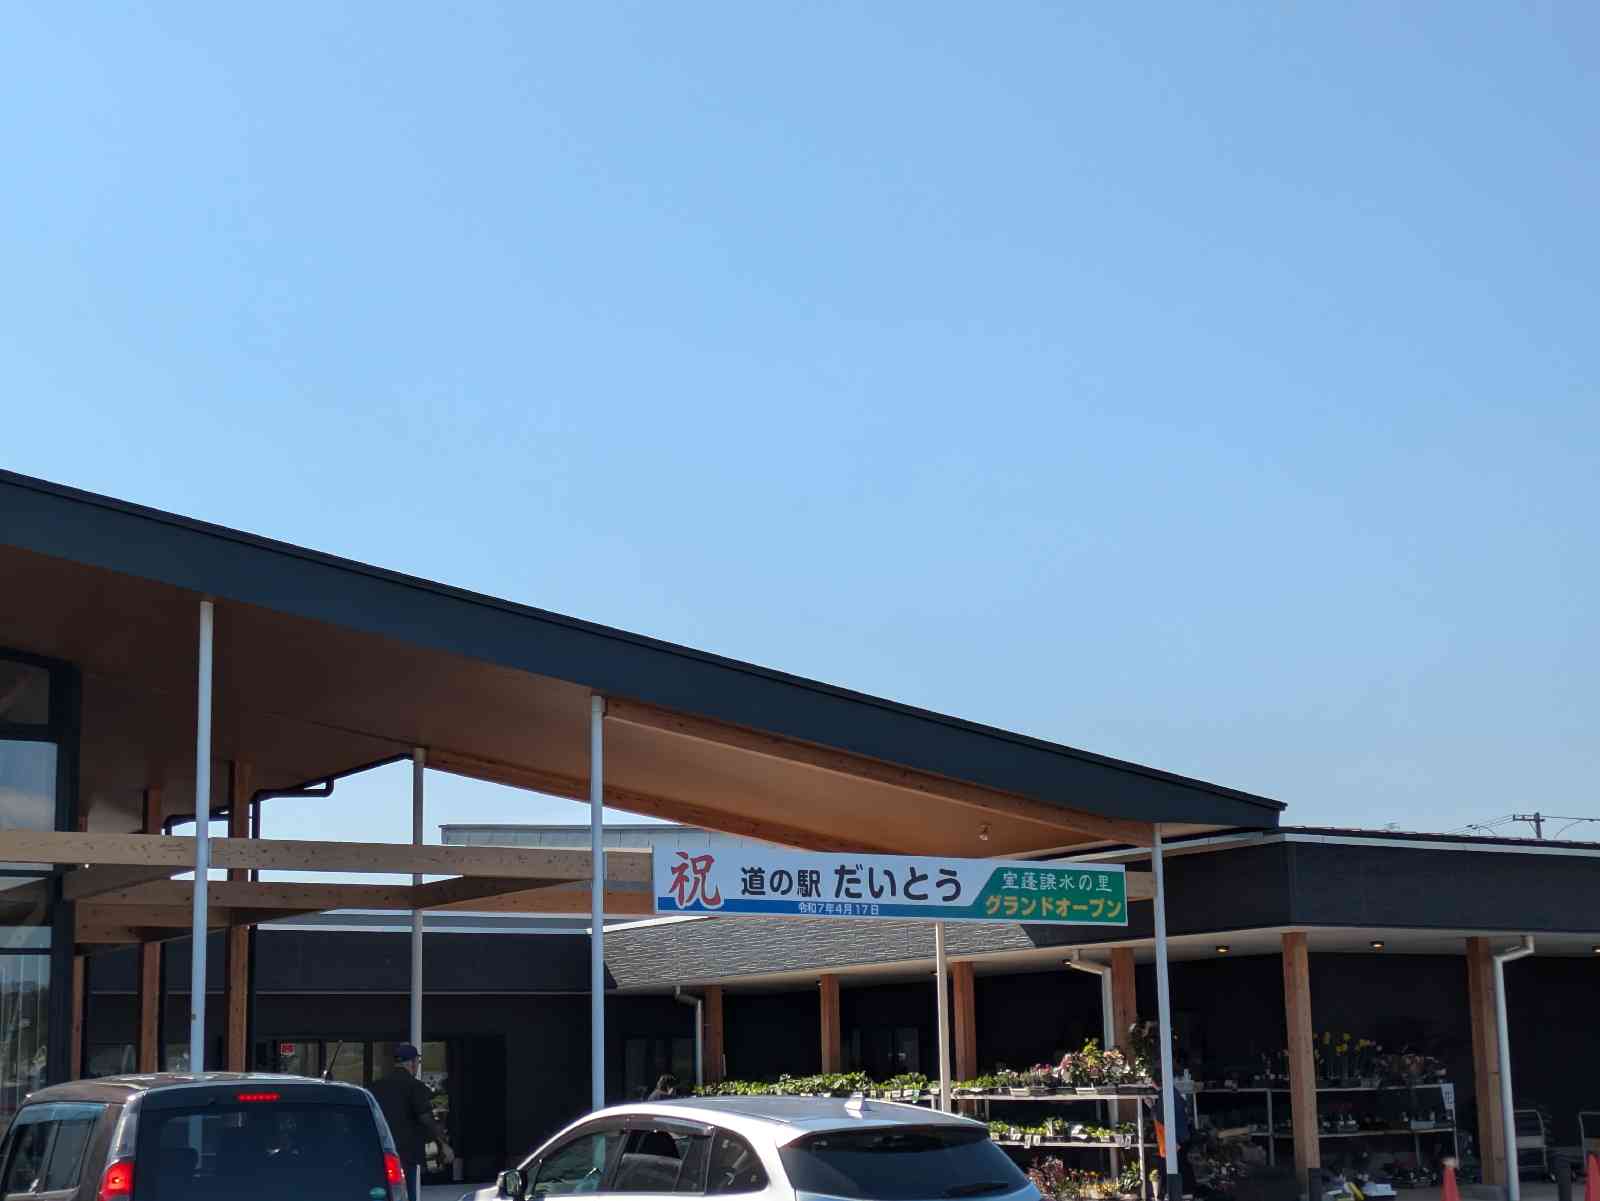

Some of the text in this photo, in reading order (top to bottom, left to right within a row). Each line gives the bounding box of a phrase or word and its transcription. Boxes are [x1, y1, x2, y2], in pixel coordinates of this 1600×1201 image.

[669, 851, 722, 907] 祝
[741, 864, 962, 902] 道の駅 だいとう
[799, 902, 880, 916] 令和7年4月17日
[985, 895, 1122, 919] グランドオープン
